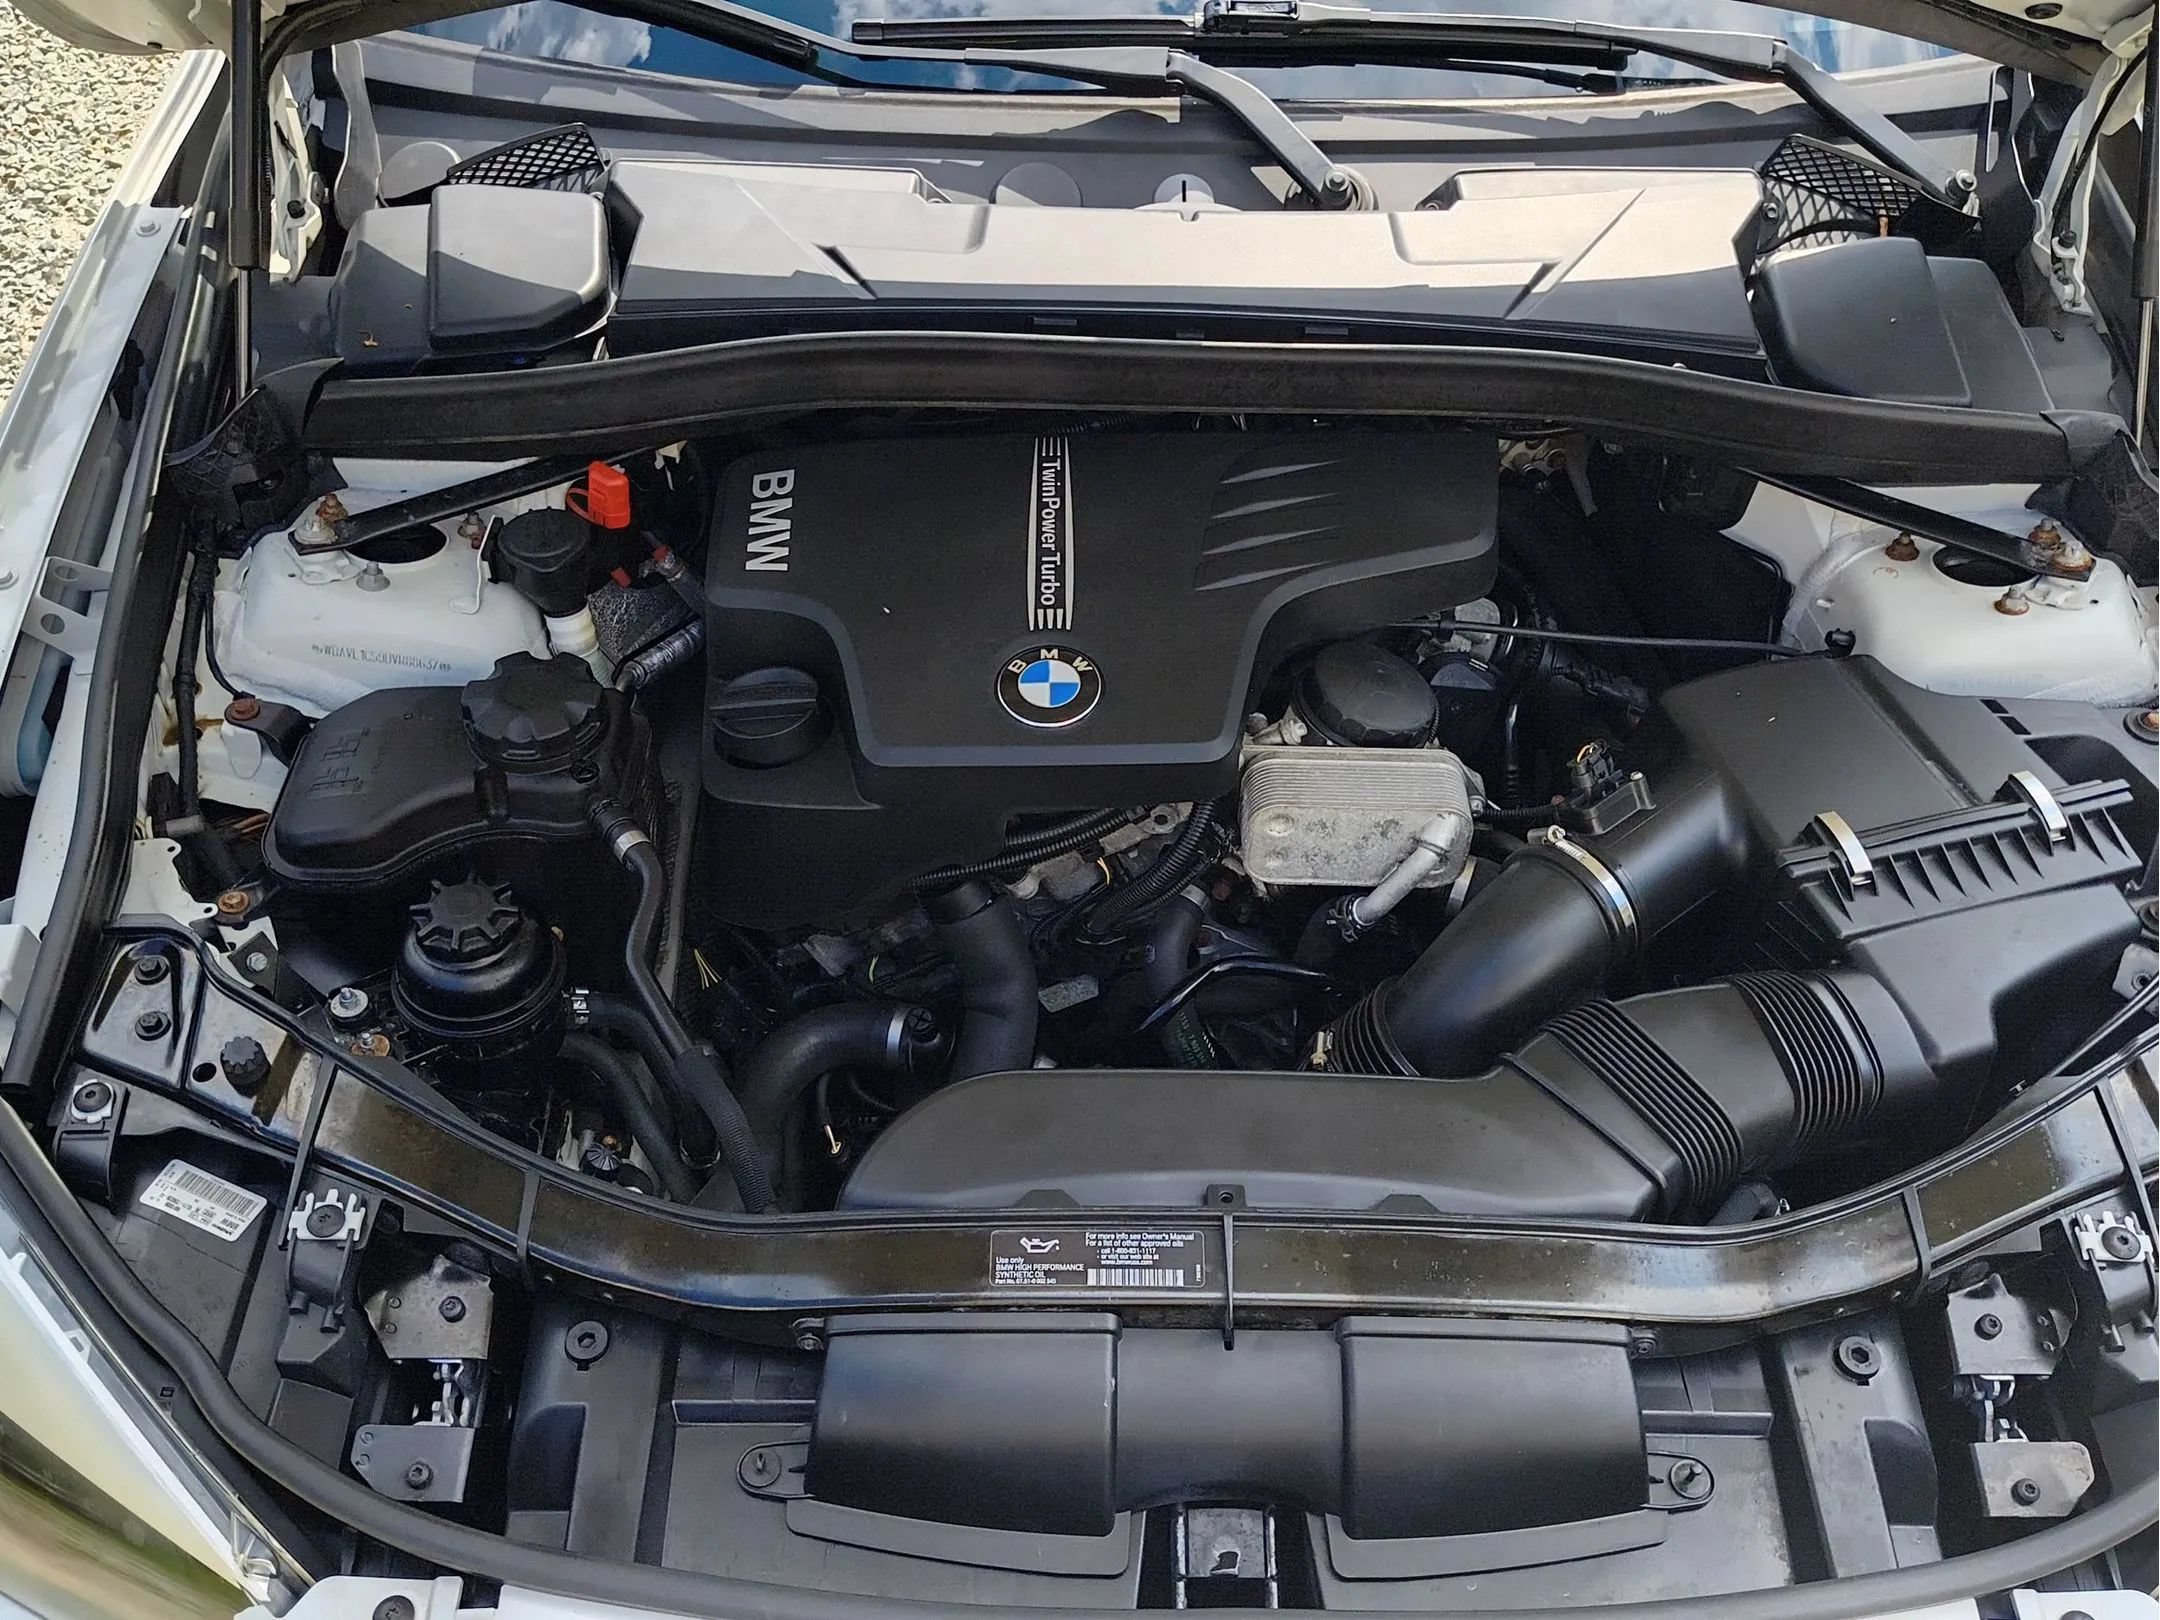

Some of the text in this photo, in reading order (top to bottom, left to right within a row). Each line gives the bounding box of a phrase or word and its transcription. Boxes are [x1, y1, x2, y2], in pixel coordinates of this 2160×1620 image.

[745, 468, 796, 572] BMW
[1041, 457, 1061, 606] TwinPower Turbo
[1006, 648, 1094, 674] BMW
[1085, 1232, 1097, 1240] For
[1142, 1232, 1169, 1240] Owner's
[1140, 1240, 1171, 1248] approved
[1010, 1256, 1024, 1265] only
[995, 1271, 1046, 1279] SYNTHETIC OIL
